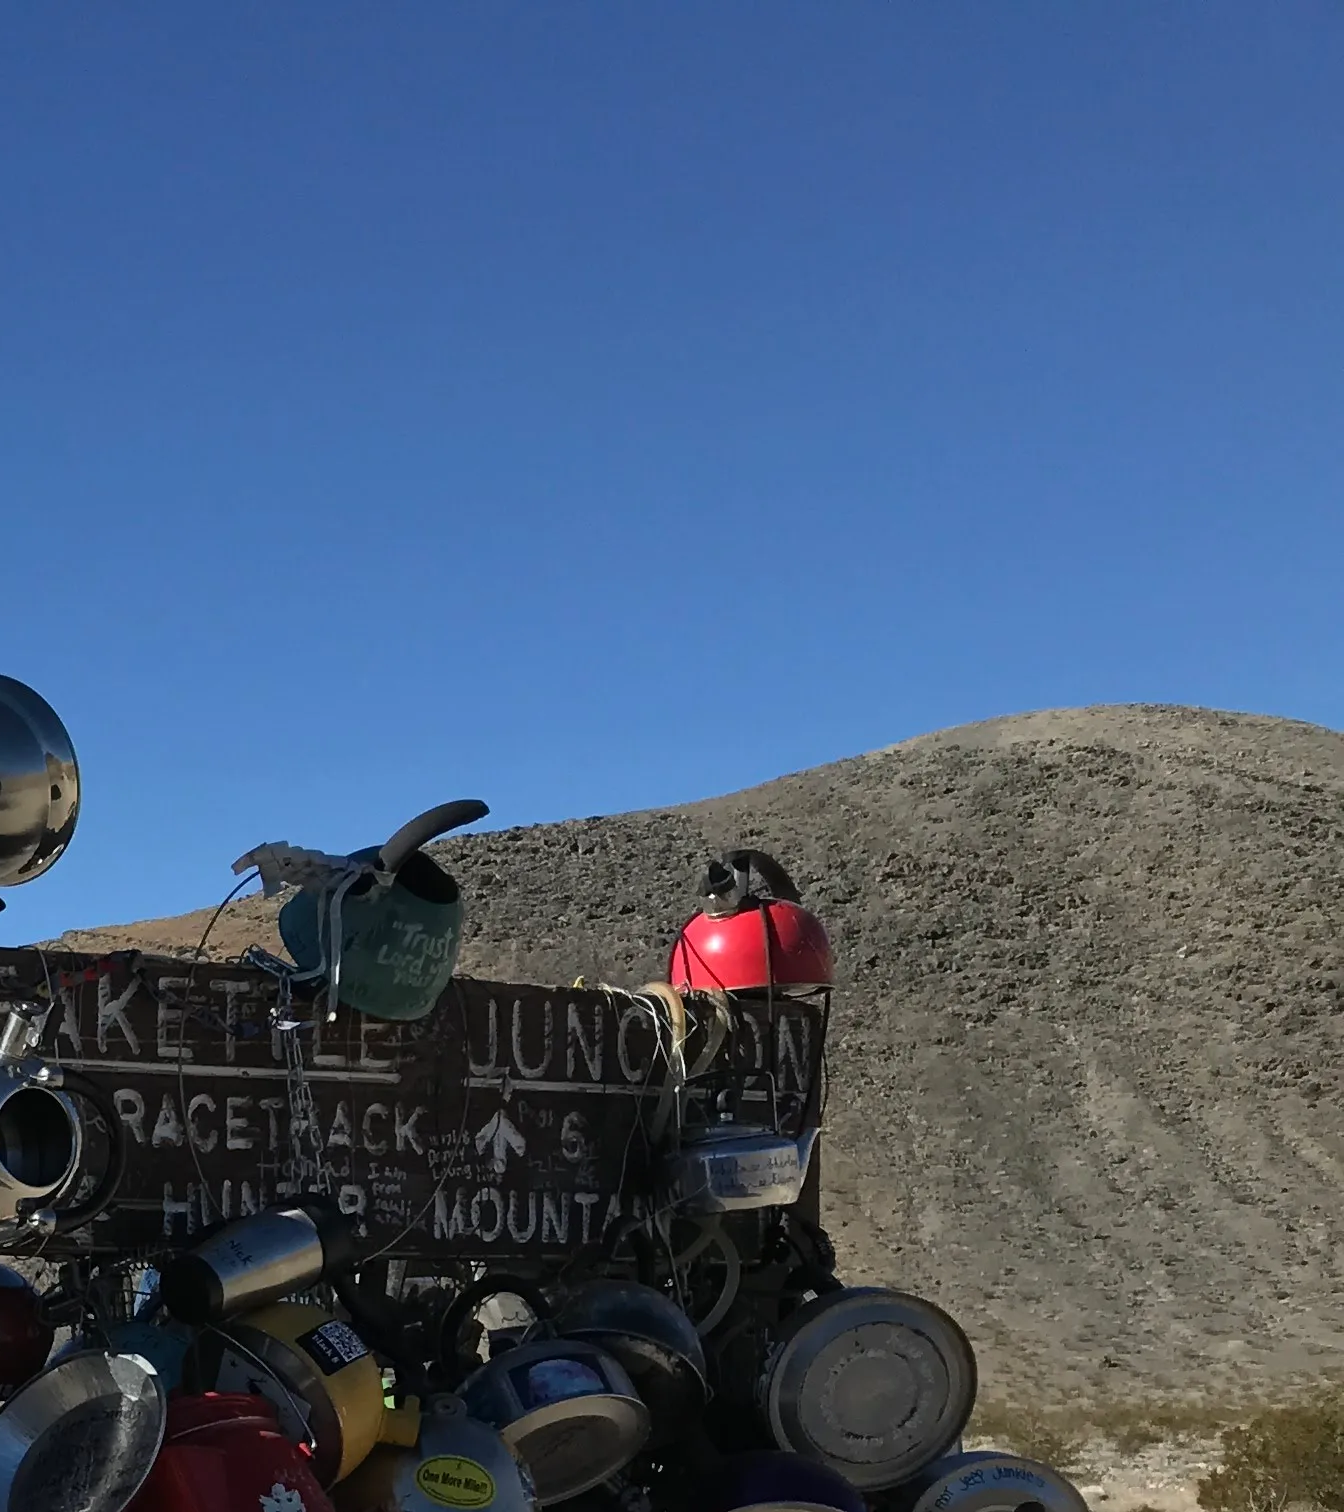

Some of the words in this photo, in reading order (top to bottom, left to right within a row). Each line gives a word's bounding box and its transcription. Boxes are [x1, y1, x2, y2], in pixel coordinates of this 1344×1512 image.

[466, 997, 811, 1093] JUNCON
[560, 1110, 586, 1164] 6
[422, 1468, 440, 1485] One
[440, 1471, 463, 1488] More
